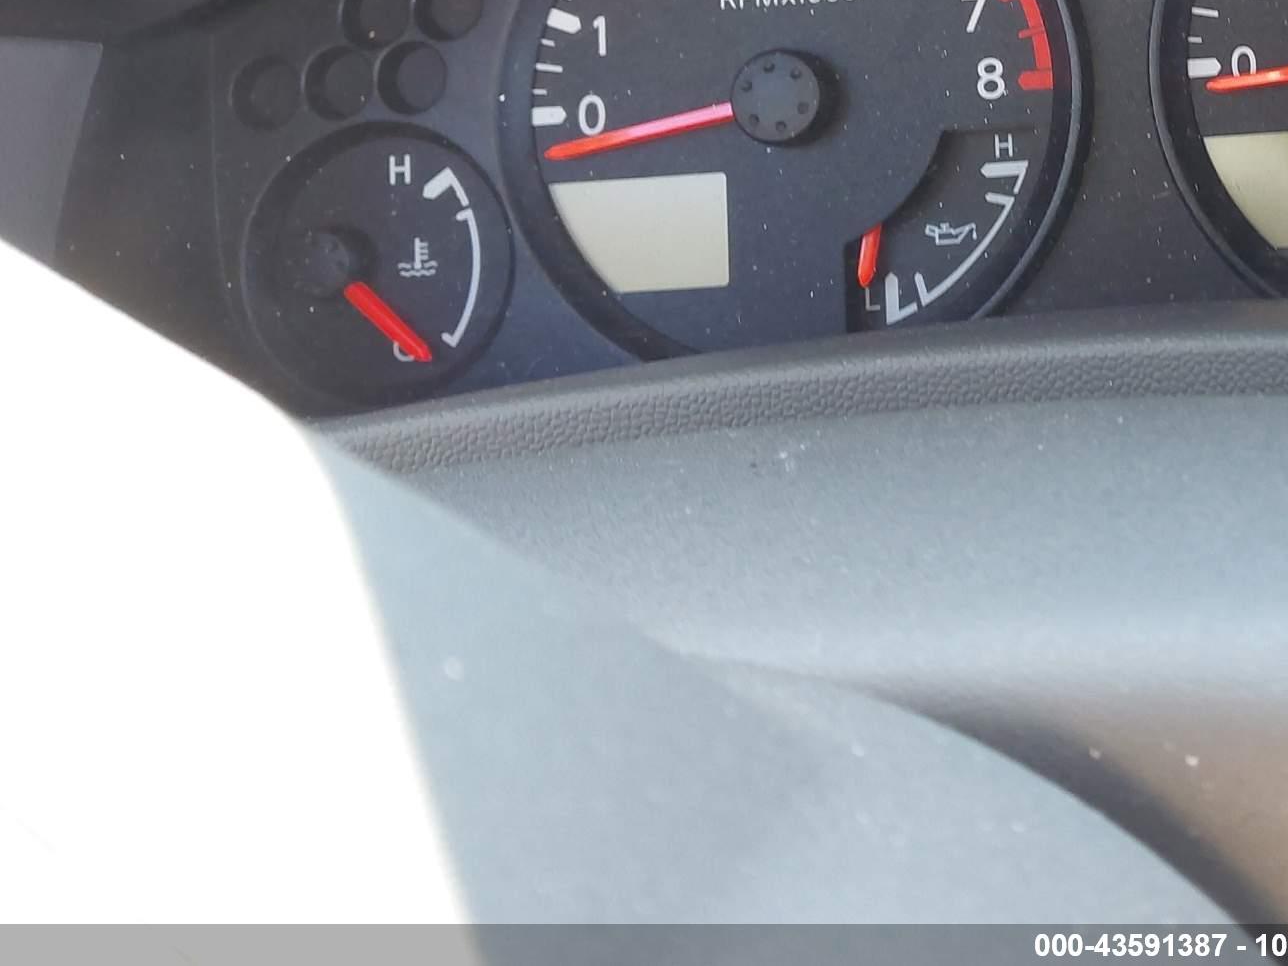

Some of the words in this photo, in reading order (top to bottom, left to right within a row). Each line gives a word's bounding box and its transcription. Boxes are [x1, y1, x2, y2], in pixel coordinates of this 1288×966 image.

[592, 15, 607, 56] 1
[1231, 45, 1257, 77] 0
[976, 57, 1006, 100] 8
[578, 93, 606, 136] 0
[994, 133, 1014, 159] H
[389, 154, 411, 185] H
[865, 287, 881, 311] L
